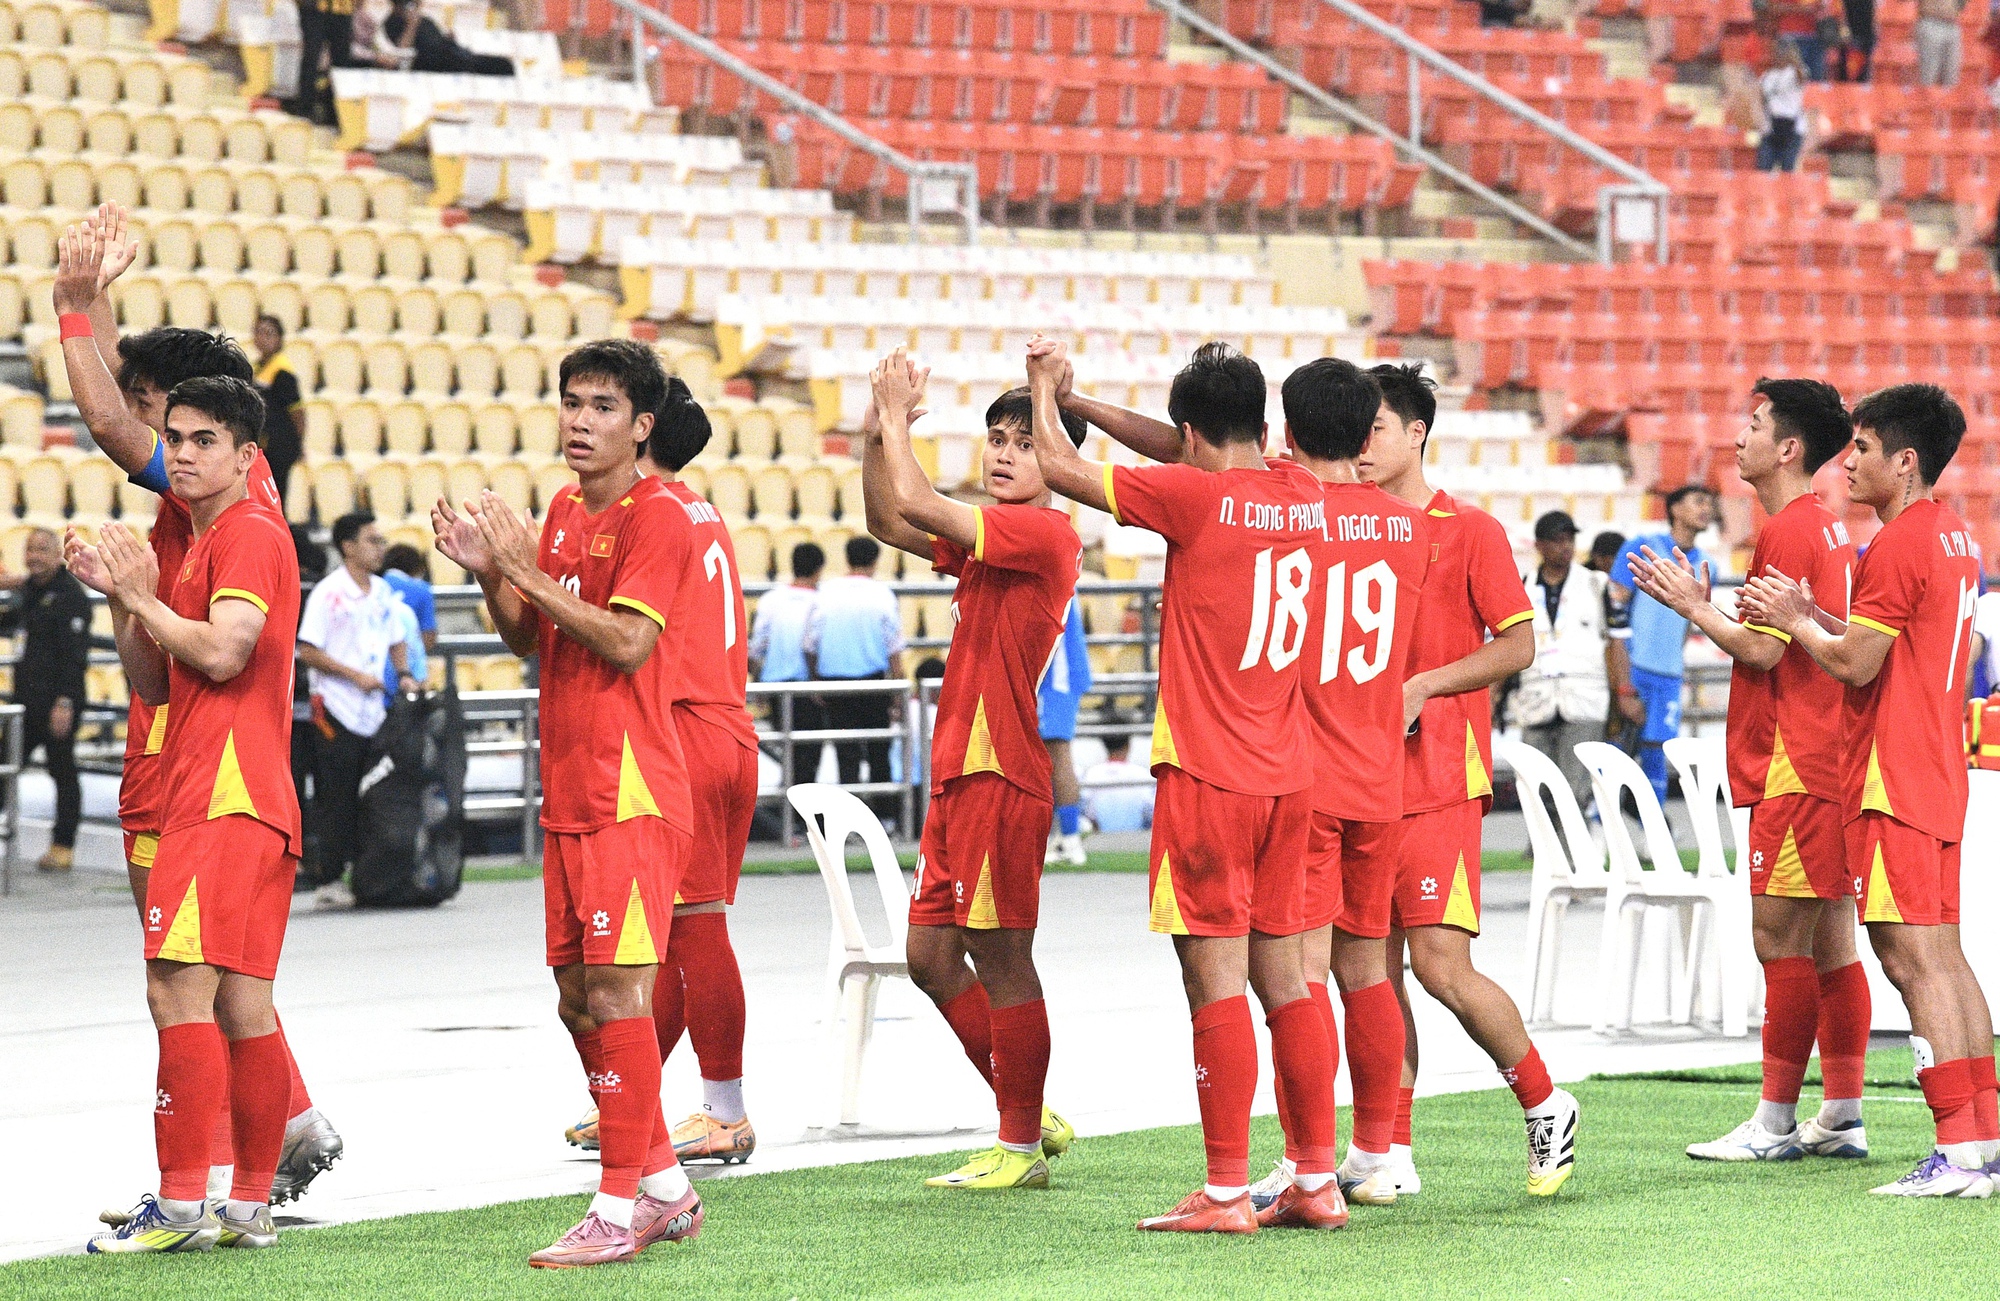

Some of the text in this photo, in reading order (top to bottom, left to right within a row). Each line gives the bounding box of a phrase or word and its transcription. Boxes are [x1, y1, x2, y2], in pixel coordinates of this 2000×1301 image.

[1218, 496, 1237, 526] N.
[1244, 501, 1284, 531] CONG
[1337, 514, 1382, 542] NGOC
[1386, 516, 1413, 543] MY
[703, 539, 736, 654] 7
[1238, 546, 1313, 673] 18
[1319, 559, 1398, 685] 19
